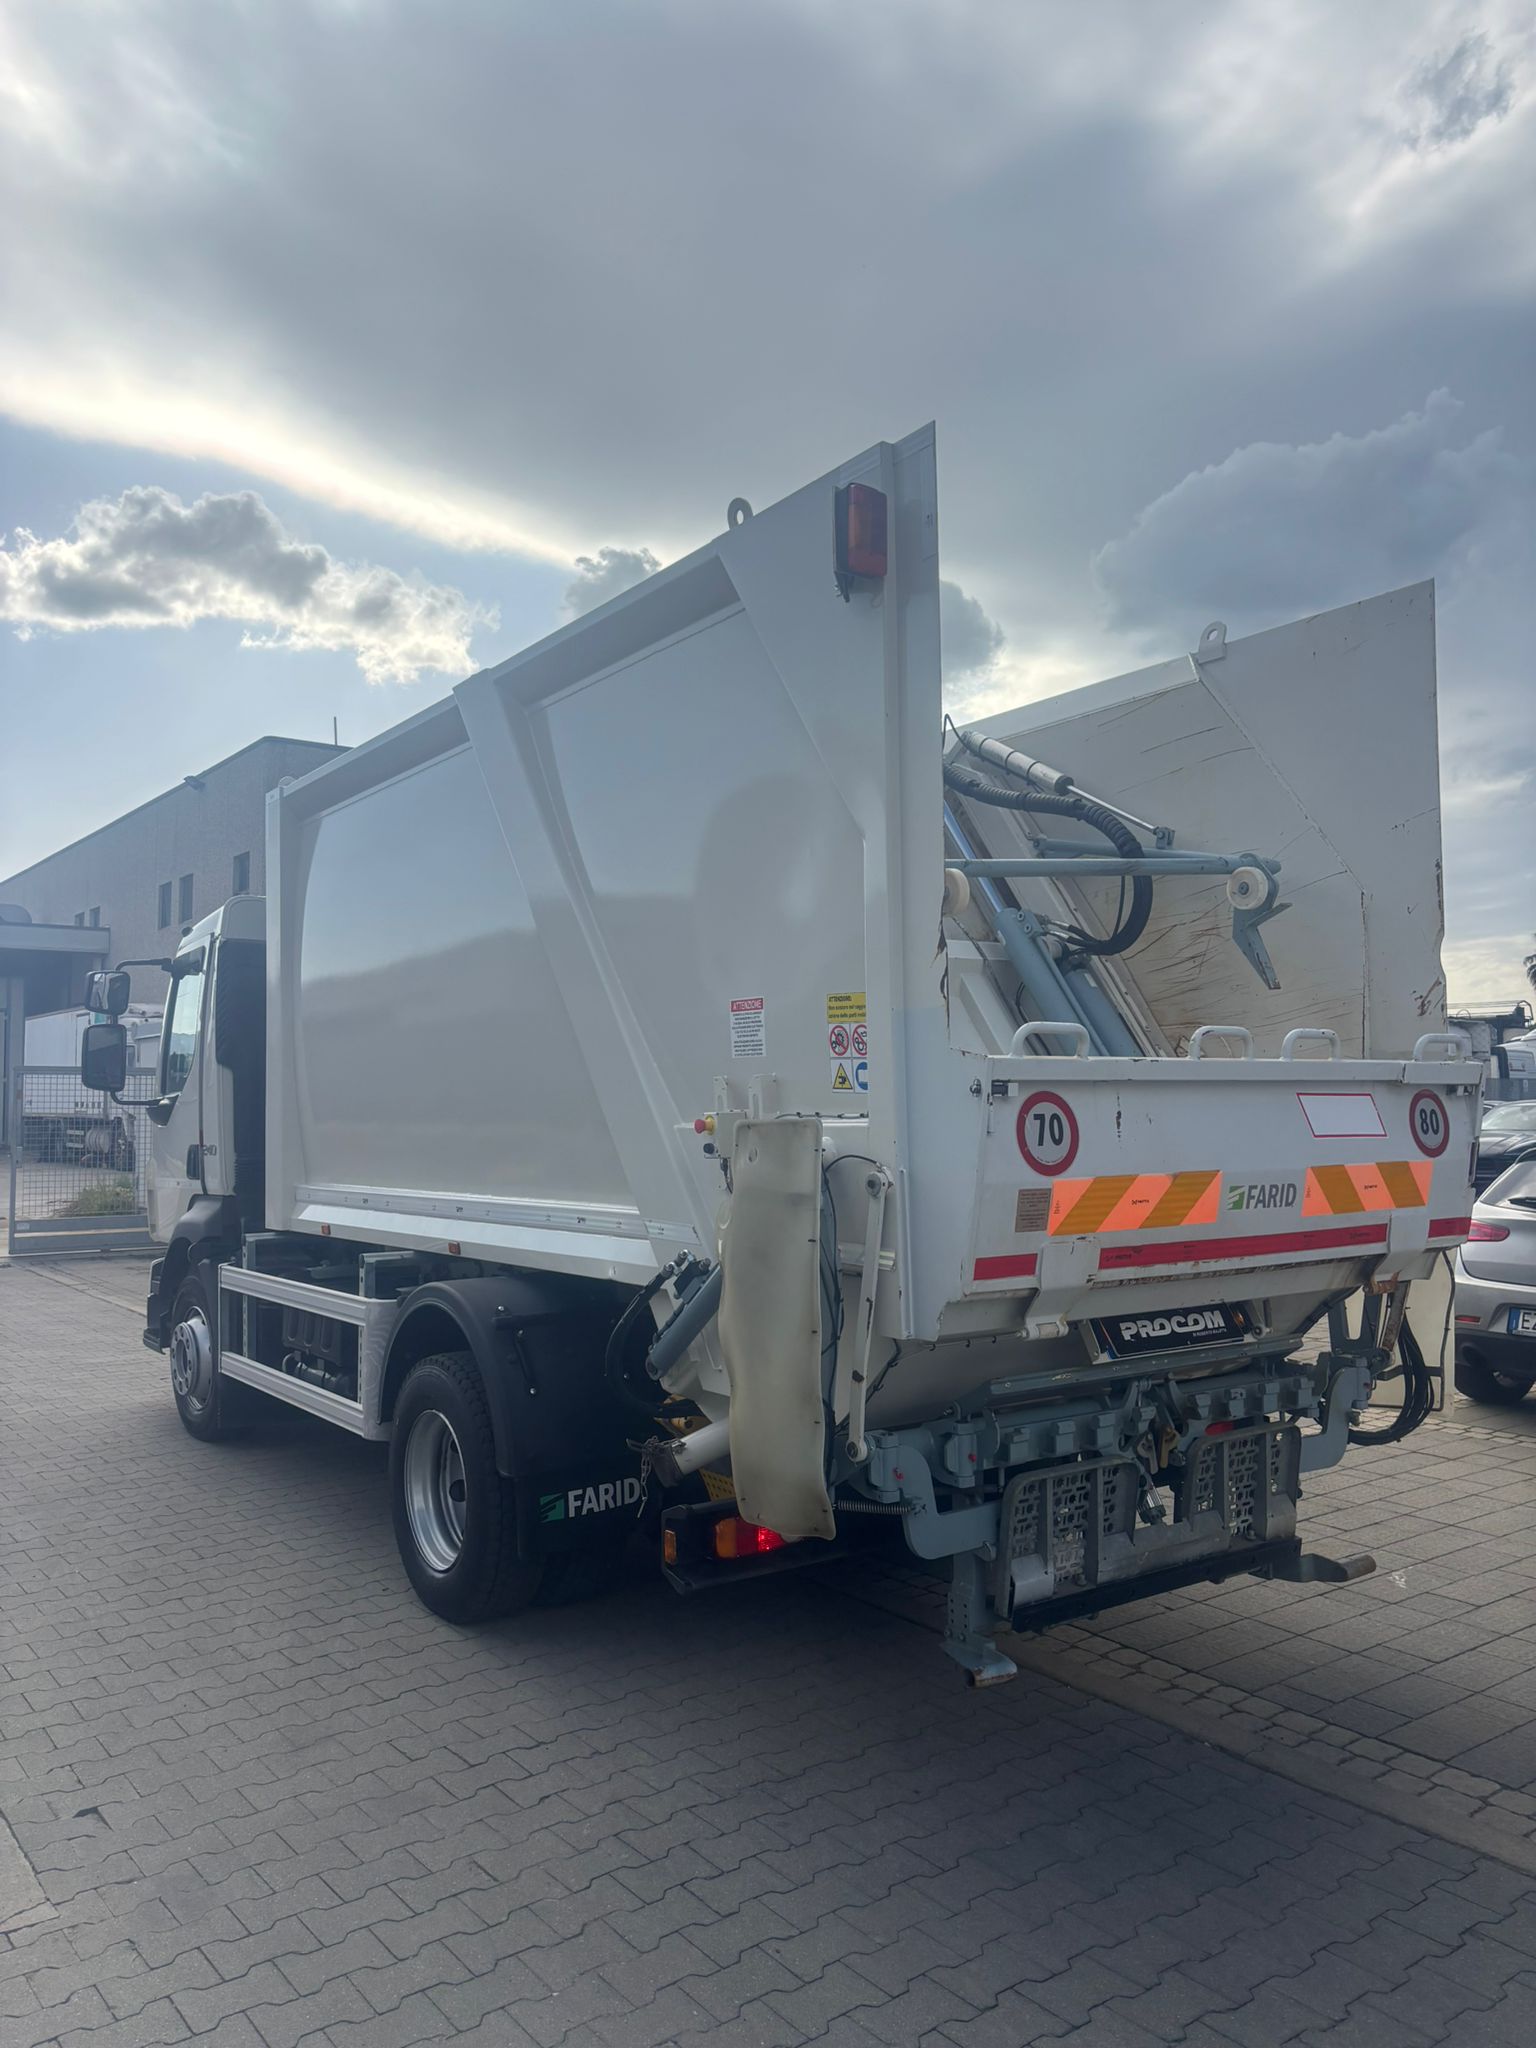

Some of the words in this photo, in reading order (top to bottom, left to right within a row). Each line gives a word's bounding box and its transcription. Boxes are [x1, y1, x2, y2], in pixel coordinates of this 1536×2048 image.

[1033, 1112, 1064, 1147] 70
[1419, 1108, 1440, 1135] 80
[1246, 1183, 1297, 1209] FARID
[1120, 1310, 1226, 1341] PROCOM
[567, 1477, 641, 1518] FARID
